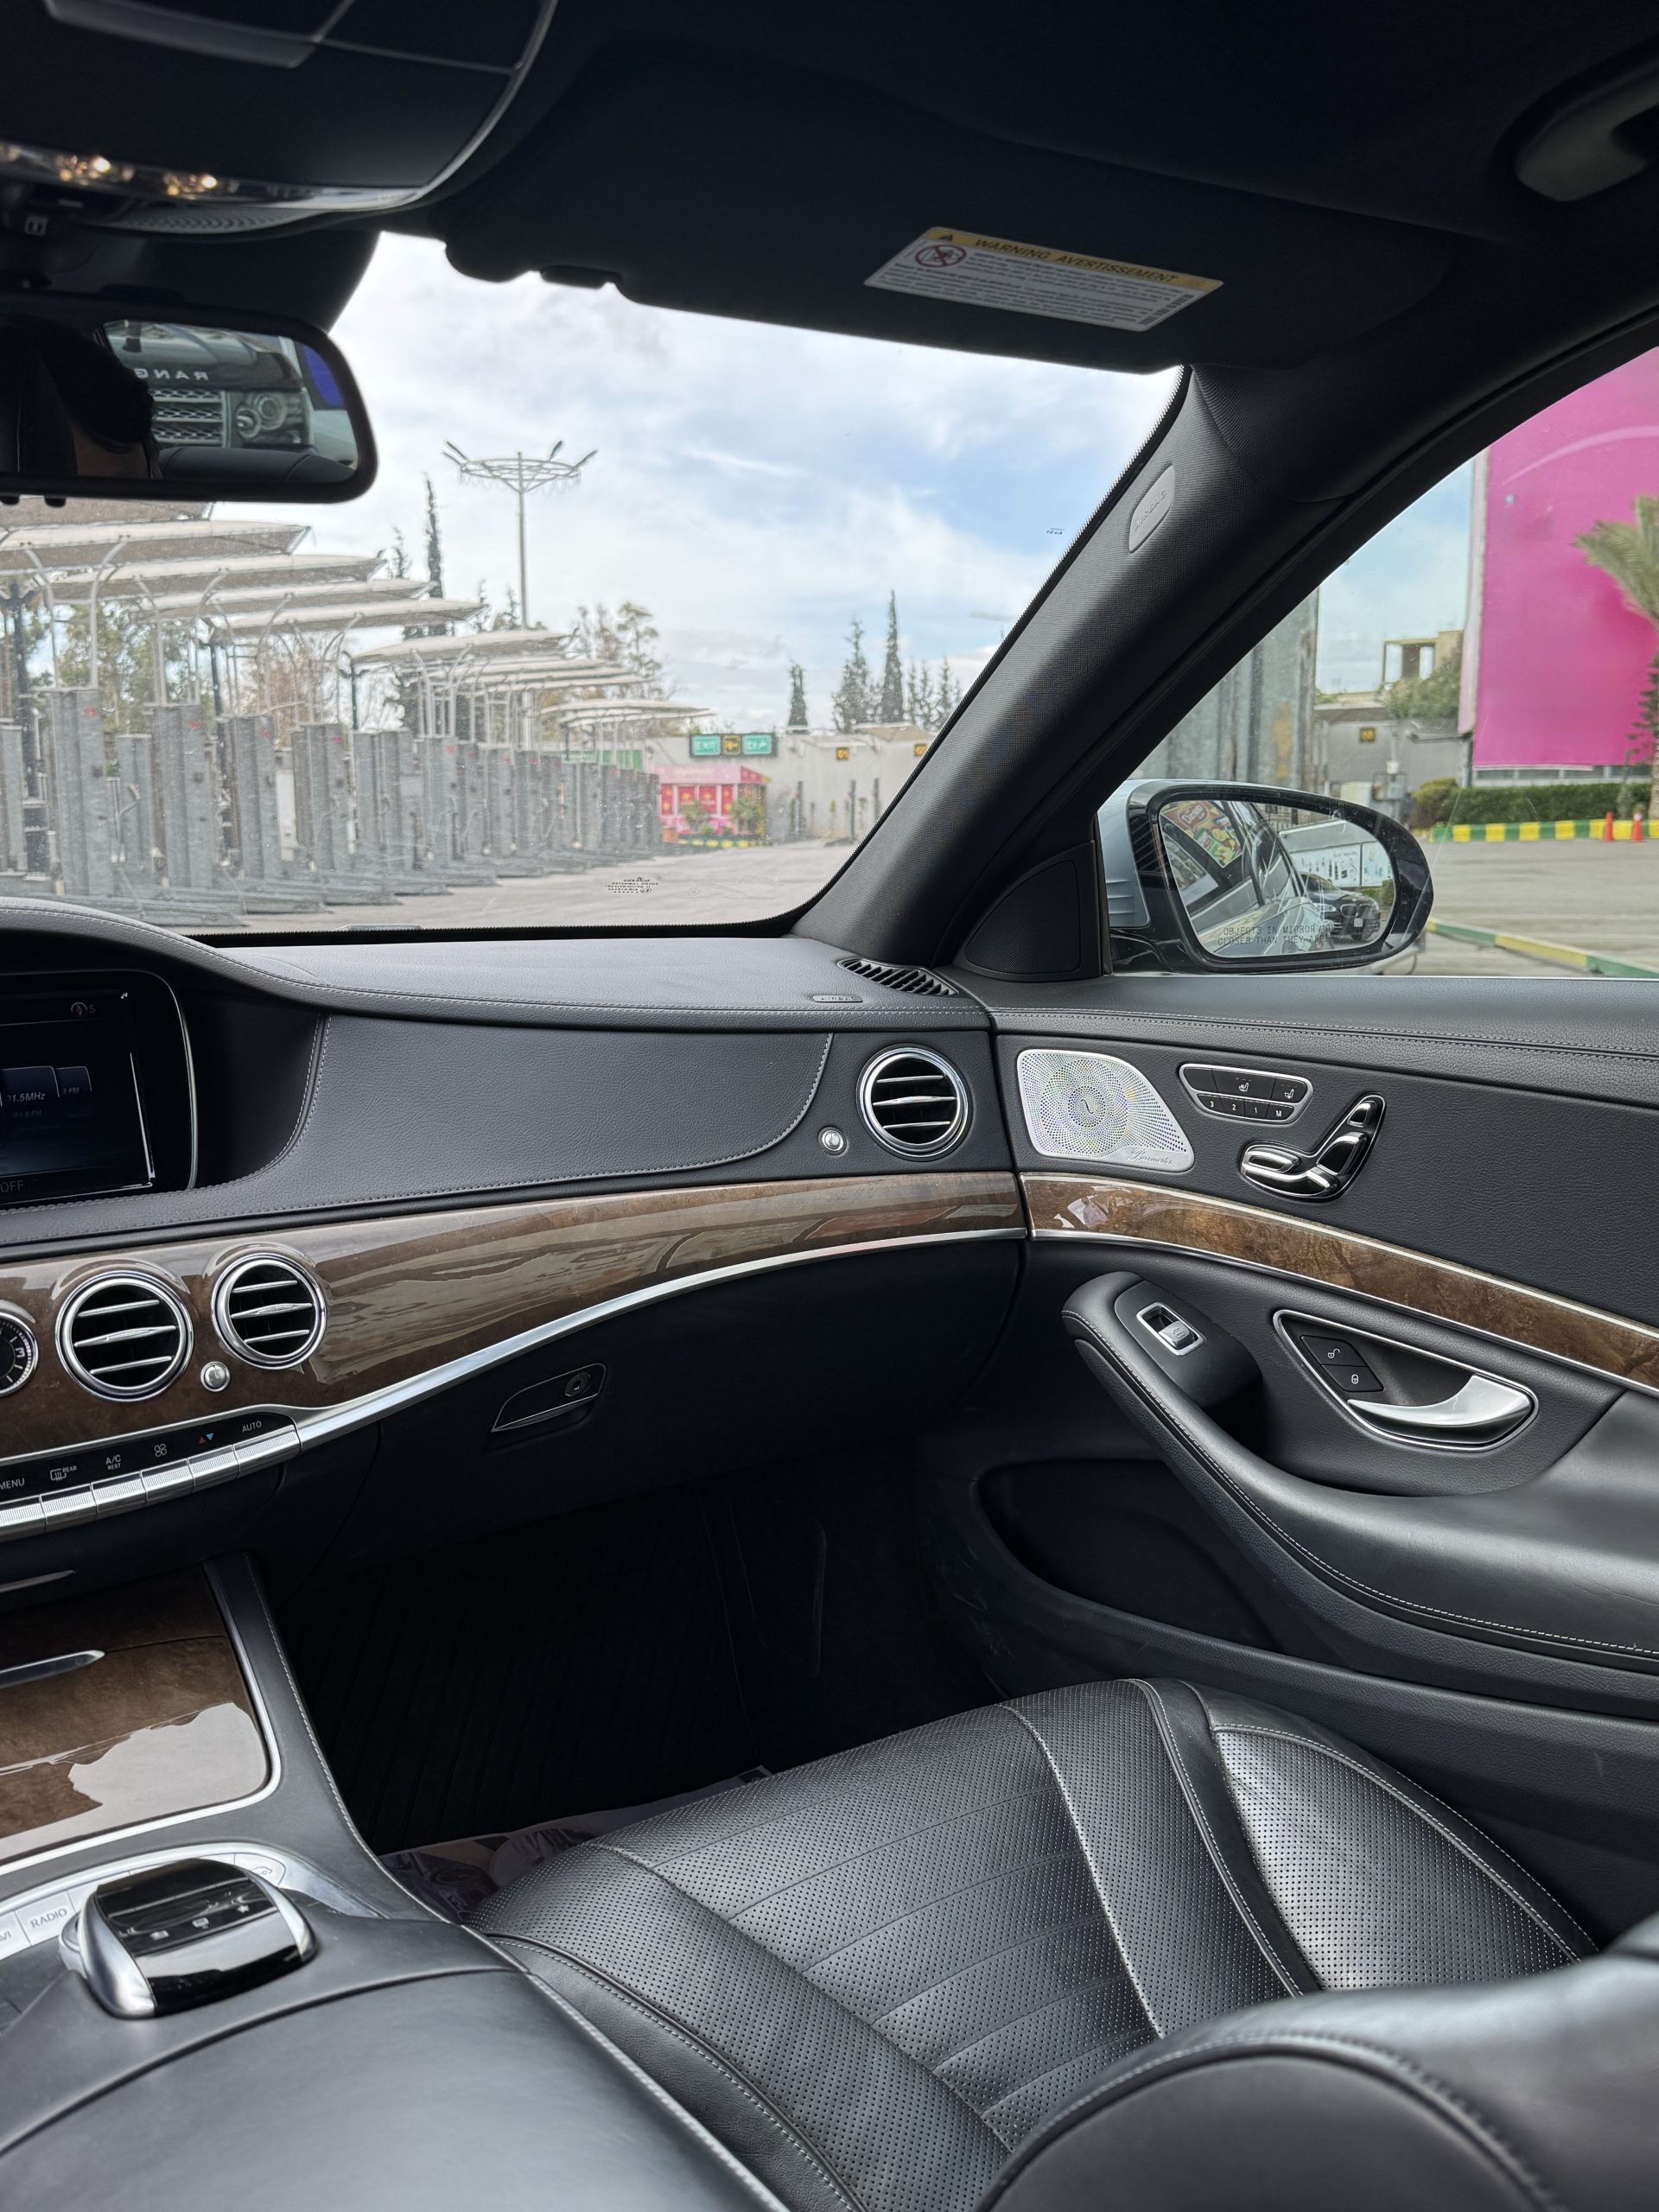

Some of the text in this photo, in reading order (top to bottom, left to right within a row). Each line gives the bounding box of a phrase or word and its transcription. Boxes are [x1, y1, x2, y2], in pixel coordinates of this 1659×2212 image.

[975, 238, 1179, 283] WARNING AVERTISSEMENT
[1223, 926, 1262, 936] OBJECTS
[1268, 925, 1277, 934] IN
[1283, 925, 1315, 934] MIRROR
[1217, 937, 1251, 945] CLOSER
[1256, 936, 1277, 944] THAN
[1, 1179, 23, 1192] OFF
[242, 1421, 262, 1433] AUTO
[105, 1454, 122, 1465] A/C
[0, 1478, 25, 1491] MENU
[30, 1908, 67, 1929] RADIO
[0, 1929, 12, 1942] VI
